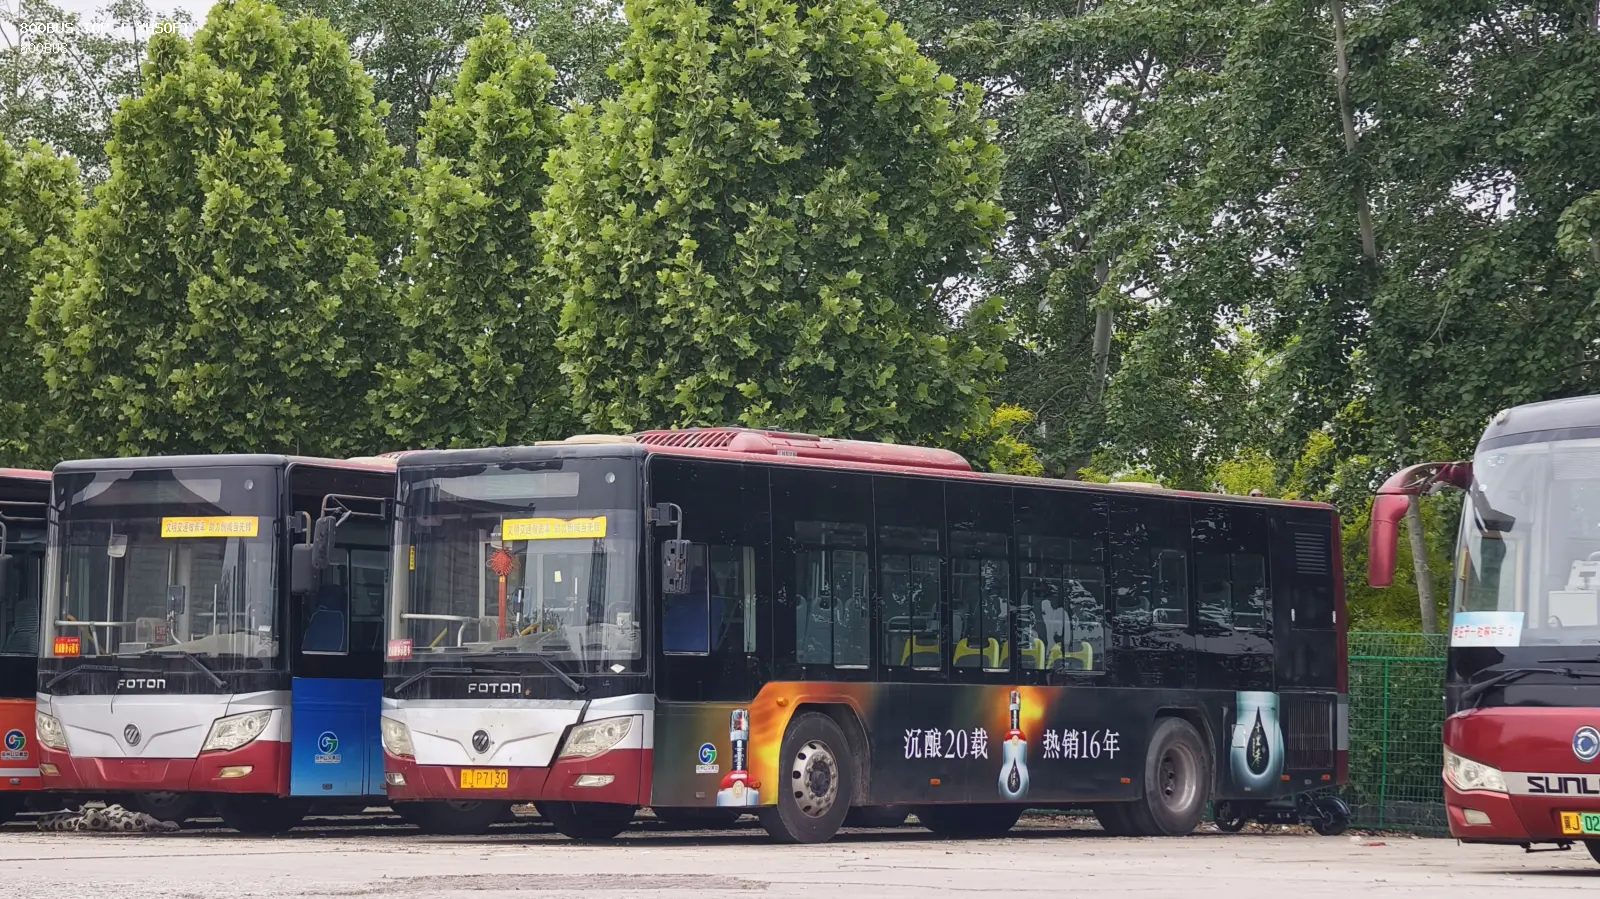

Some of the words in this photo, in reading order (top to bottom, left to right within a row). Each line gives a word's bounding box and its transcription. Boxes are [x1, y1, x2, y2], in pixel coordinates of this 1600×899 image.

[117, 679, 166, 689] FOTON
[468, 683, 522, 694] FOTON
[903, 727, 989, 760] 沉酿20载
[1042, 728, 1121, 760] 热销16年
[1527, 776, 1600, 794] SUNL
